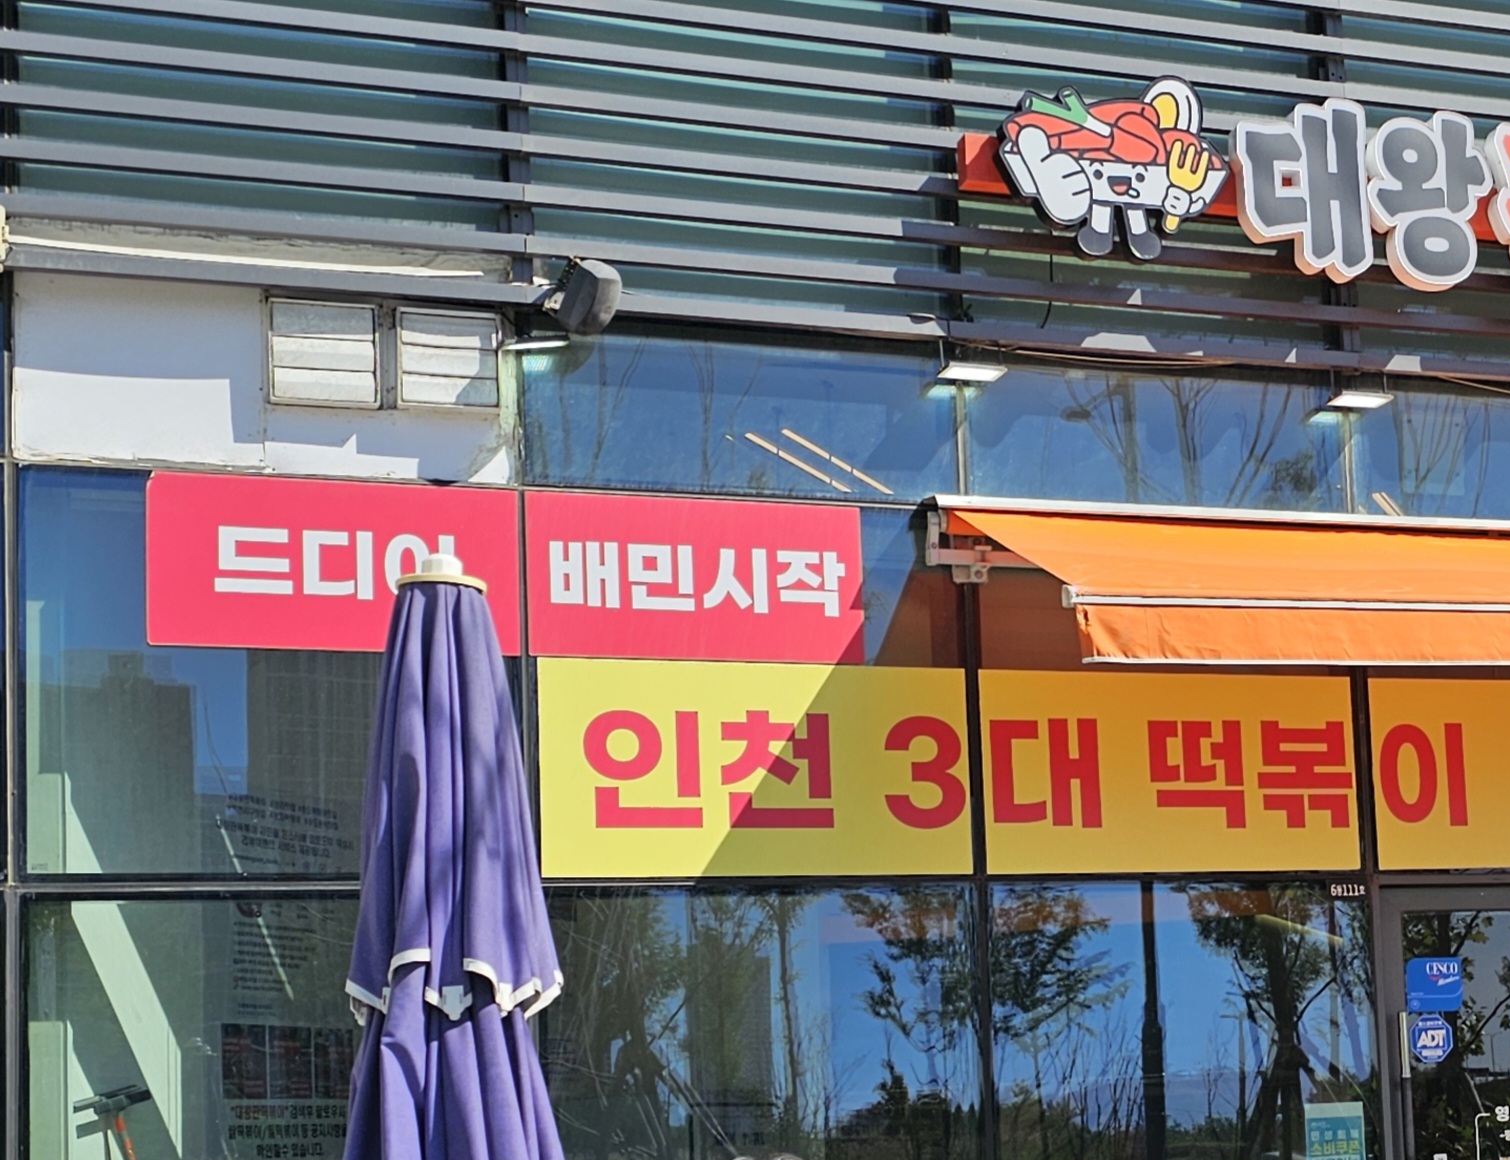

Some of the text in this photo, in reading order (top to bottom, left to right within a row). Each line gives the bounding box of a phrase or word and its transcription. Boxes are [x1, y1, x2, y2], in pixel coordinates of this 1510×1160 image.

[548, 540, 846, 617] 배민시작
[582, 708, 836, 829] 인천
[883, 715, 1103, 830] 3대
[1147, 720, 1468, 829] 떡볶이
[1426, 962, 1458, 976] CESCO
[1417, 1029, 1446, 1048] ADT
